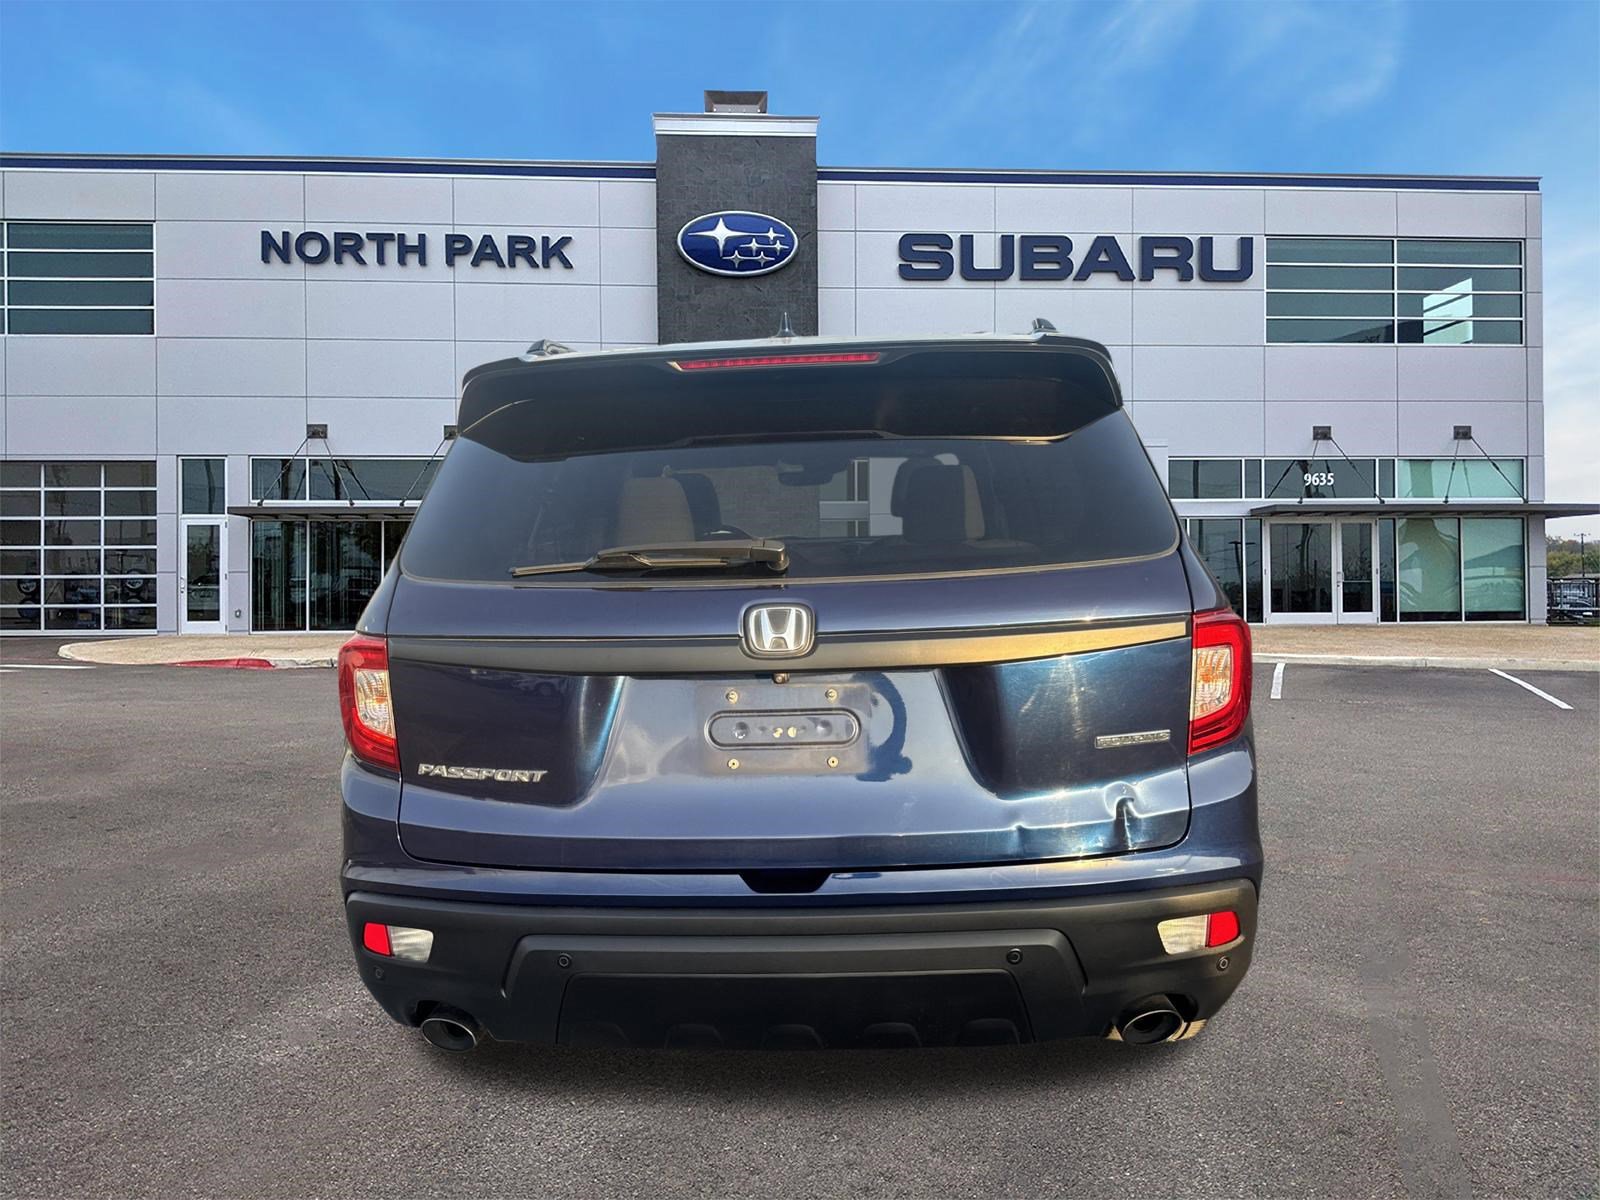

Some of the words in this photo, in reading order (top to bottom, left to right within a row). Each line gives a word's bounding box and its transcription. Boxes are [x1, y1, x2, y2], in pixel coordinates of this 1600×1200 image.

[261, 230, 428, 267] NORTH
[445, 234, 574, 269] PARK
[898, 233, 1254, 282] SUBARU
[1303, 472, 1335, 486] 9635
[417, 763, 549, 783] PASSPORT
